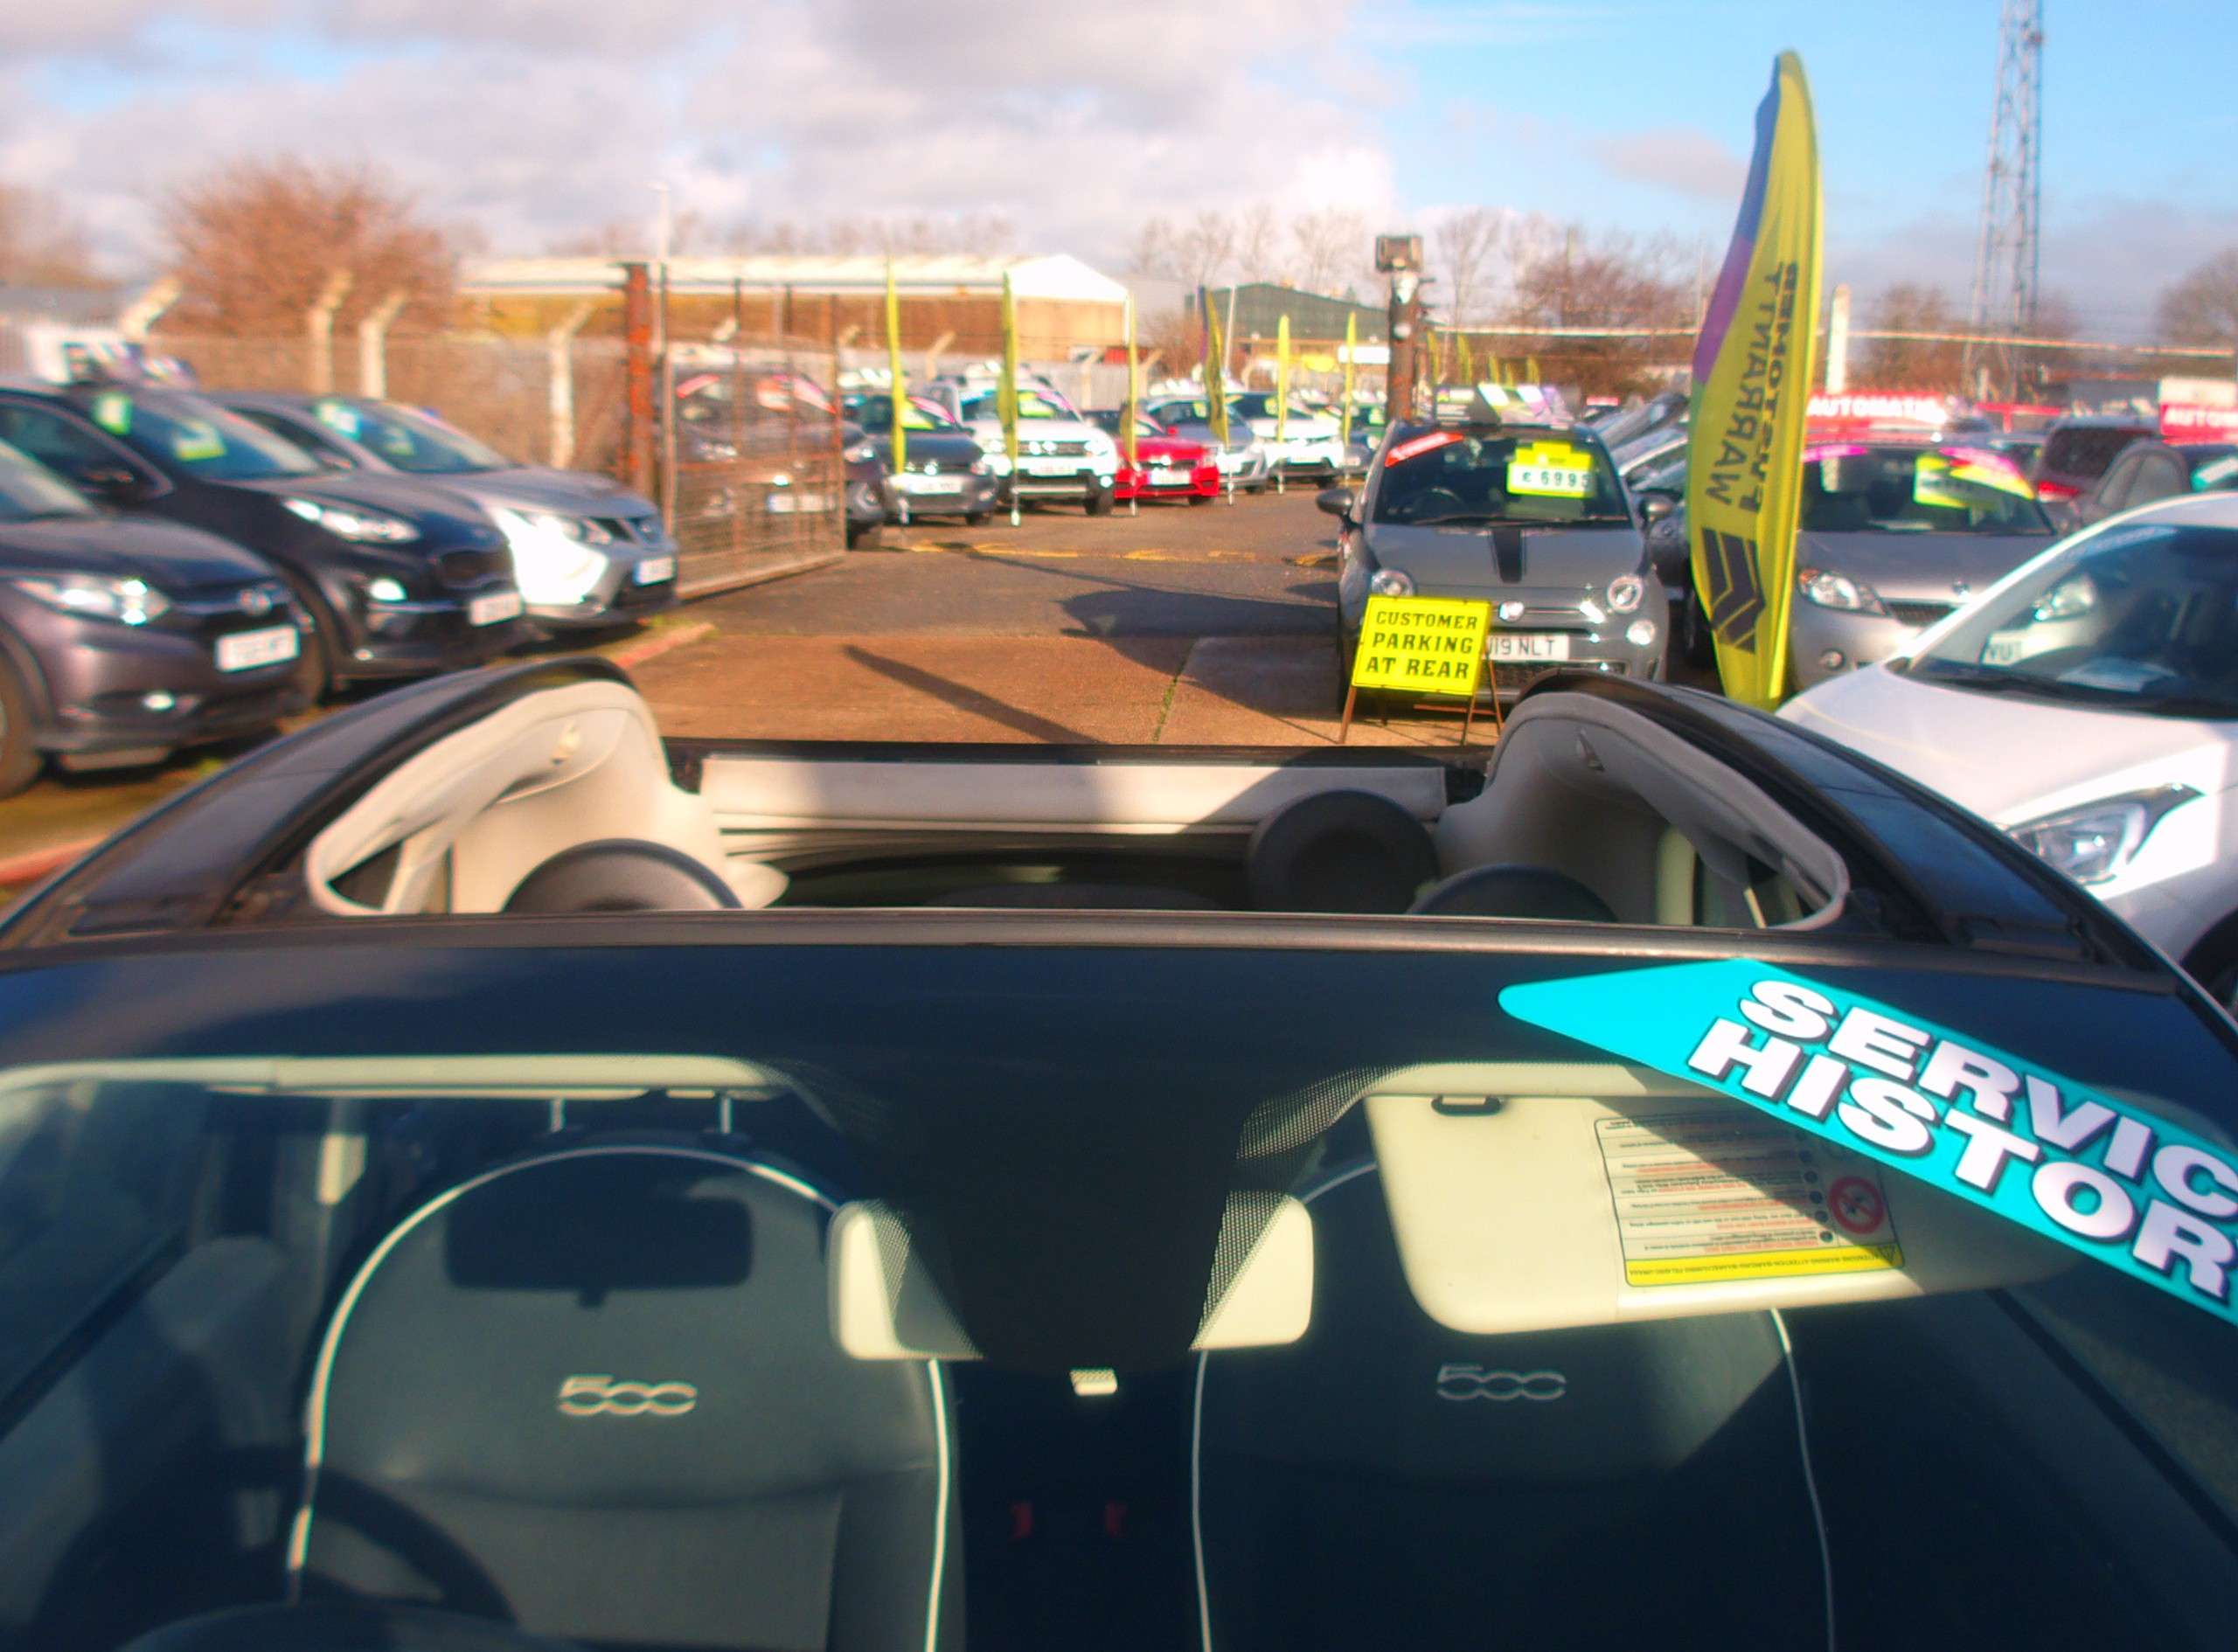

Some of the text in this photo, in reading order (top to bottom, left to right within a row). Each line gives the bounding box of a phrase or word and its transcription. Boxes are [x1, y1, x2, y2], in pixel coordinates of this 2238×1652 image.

[1375, 610, 1478, 629] CUSTOMER
[1371, 632, 1474, 655] PARKING
[1519, 637, 1555, 656] NLT
[1365, 656, 1470, 679] AT REAR
[1436, 1364, 1567, 1400] 500
[559, 1374, 698, 1416] 500
